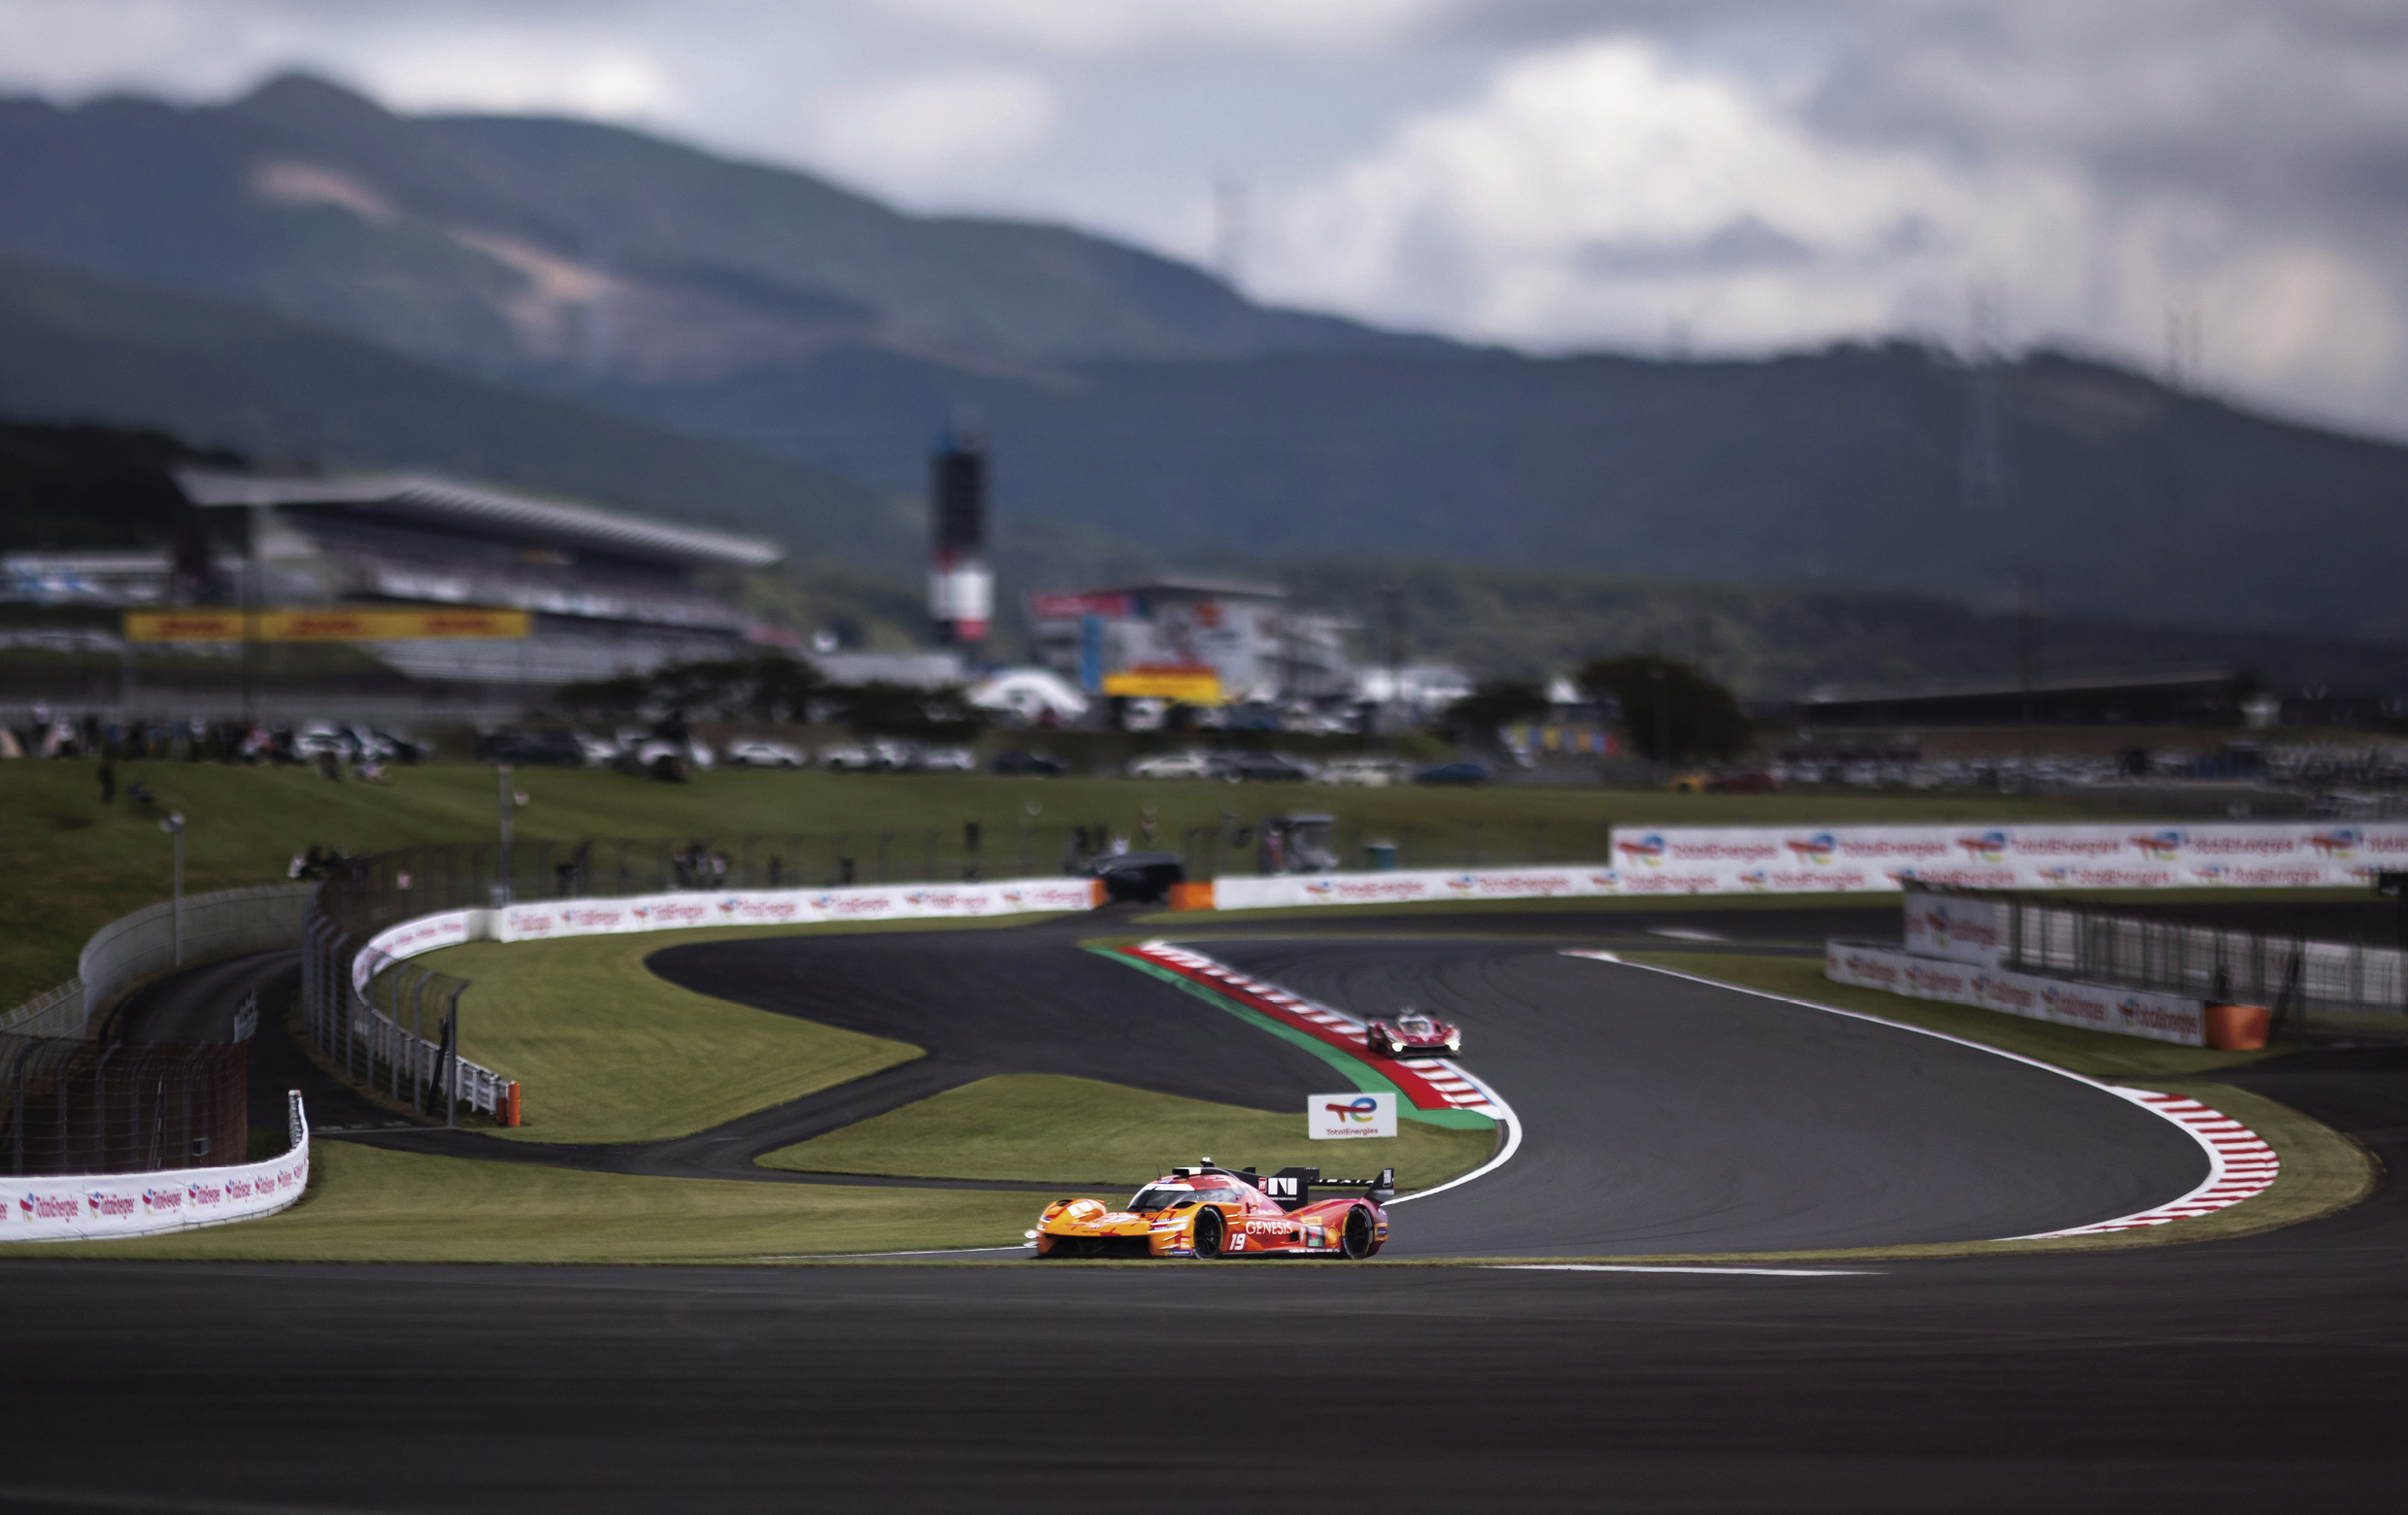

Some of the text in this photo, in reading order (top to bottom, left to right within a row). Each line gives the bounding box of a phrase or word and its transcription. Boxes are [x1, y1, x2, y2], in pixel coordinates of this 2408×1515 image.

[1326, 1128, 1379, 1136] TotalEnergies
[1246, 1221, 1293, 1235] GENESIS
[1229, 1233, 1246, 1251] 19
